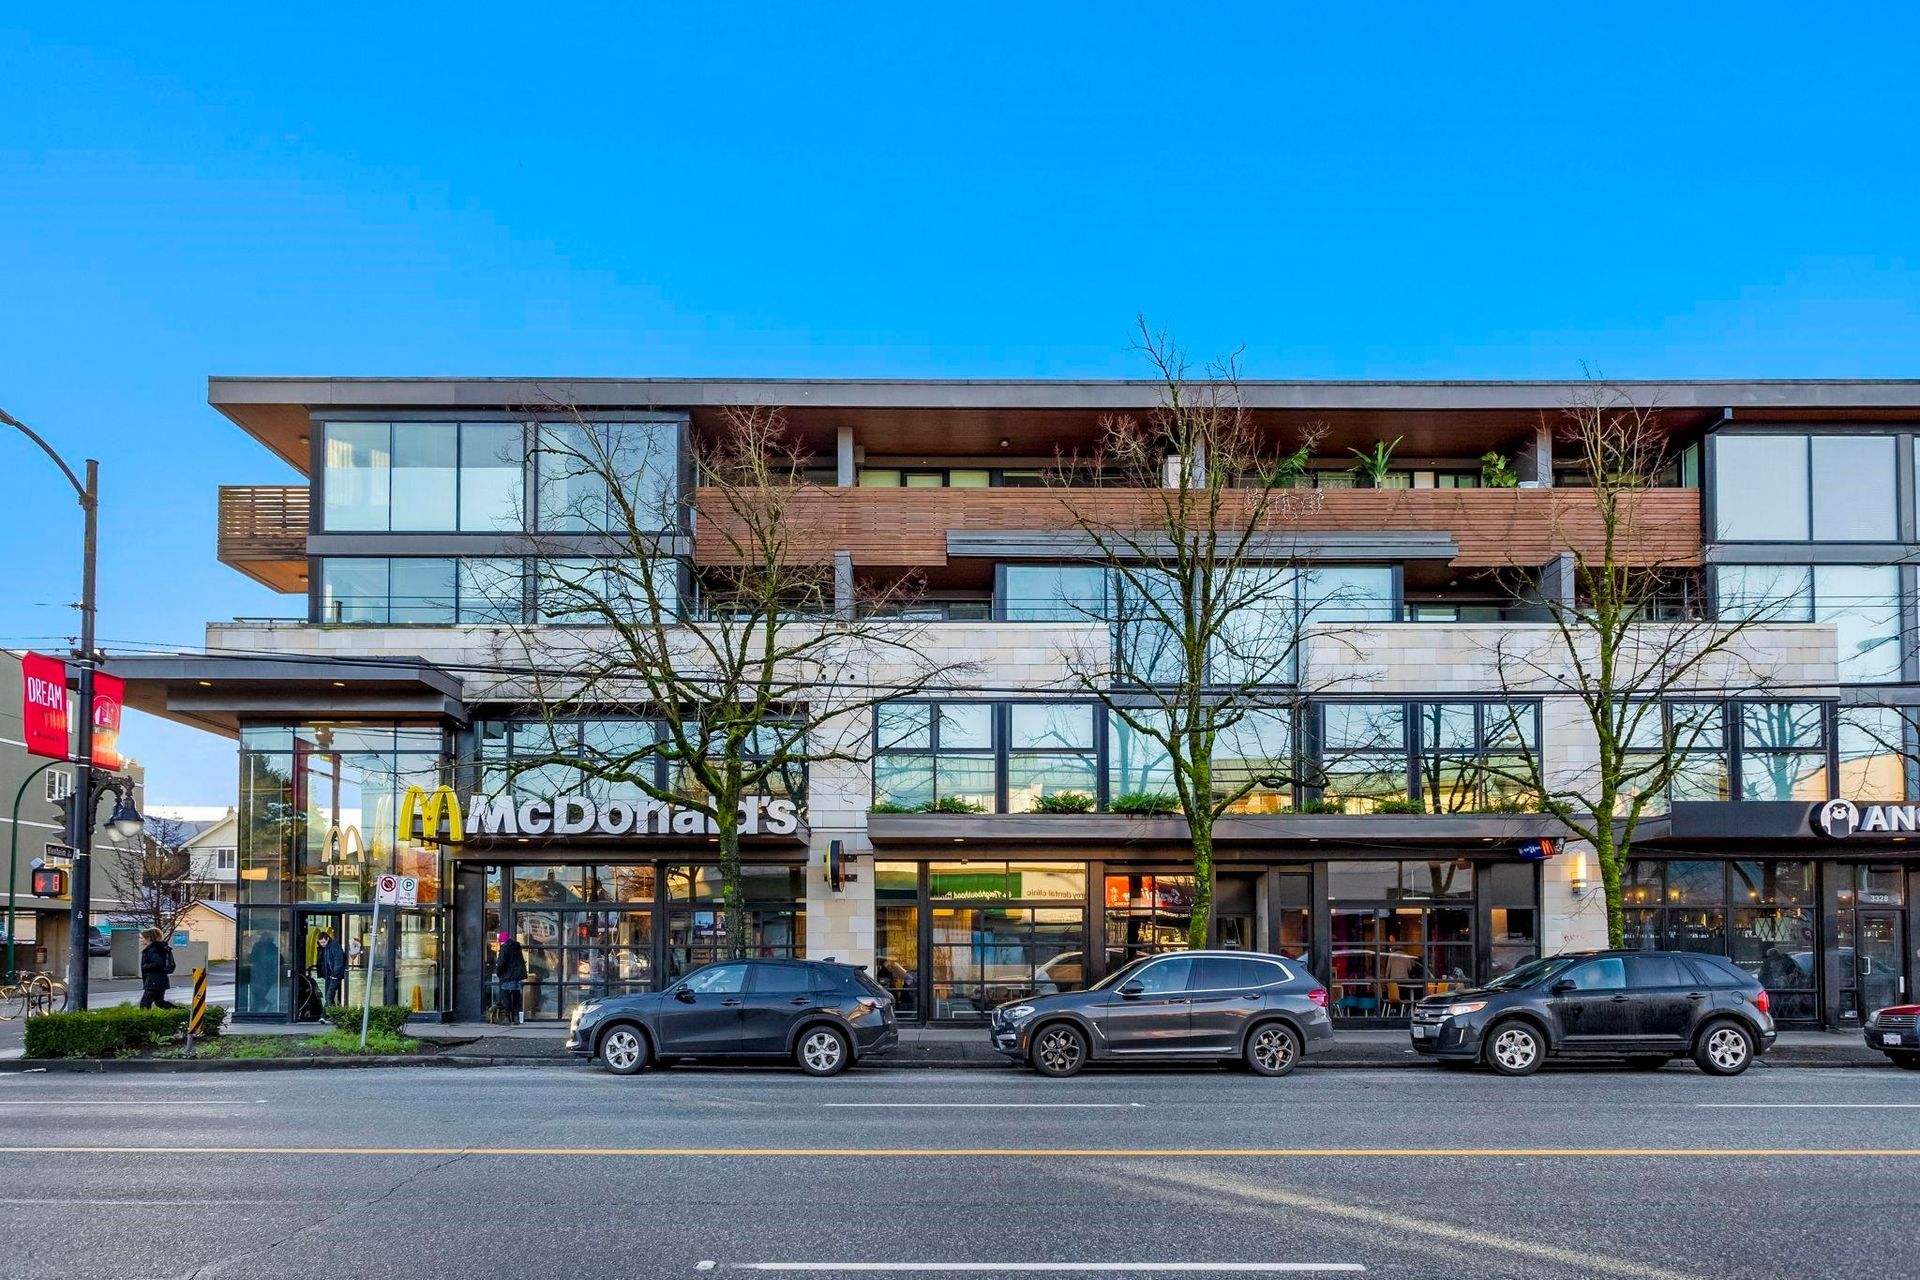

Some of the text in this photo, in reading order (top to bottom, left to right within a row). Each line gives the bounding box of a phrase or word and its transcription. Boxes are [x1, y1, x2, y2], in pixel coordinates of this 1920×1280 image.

[27, 676, 63, 712] DREAM
[465, 795, 798, 835] McDonald's
[1861, 804, 1920, 832] AN
[326, 864, 360, 876] OPEN
